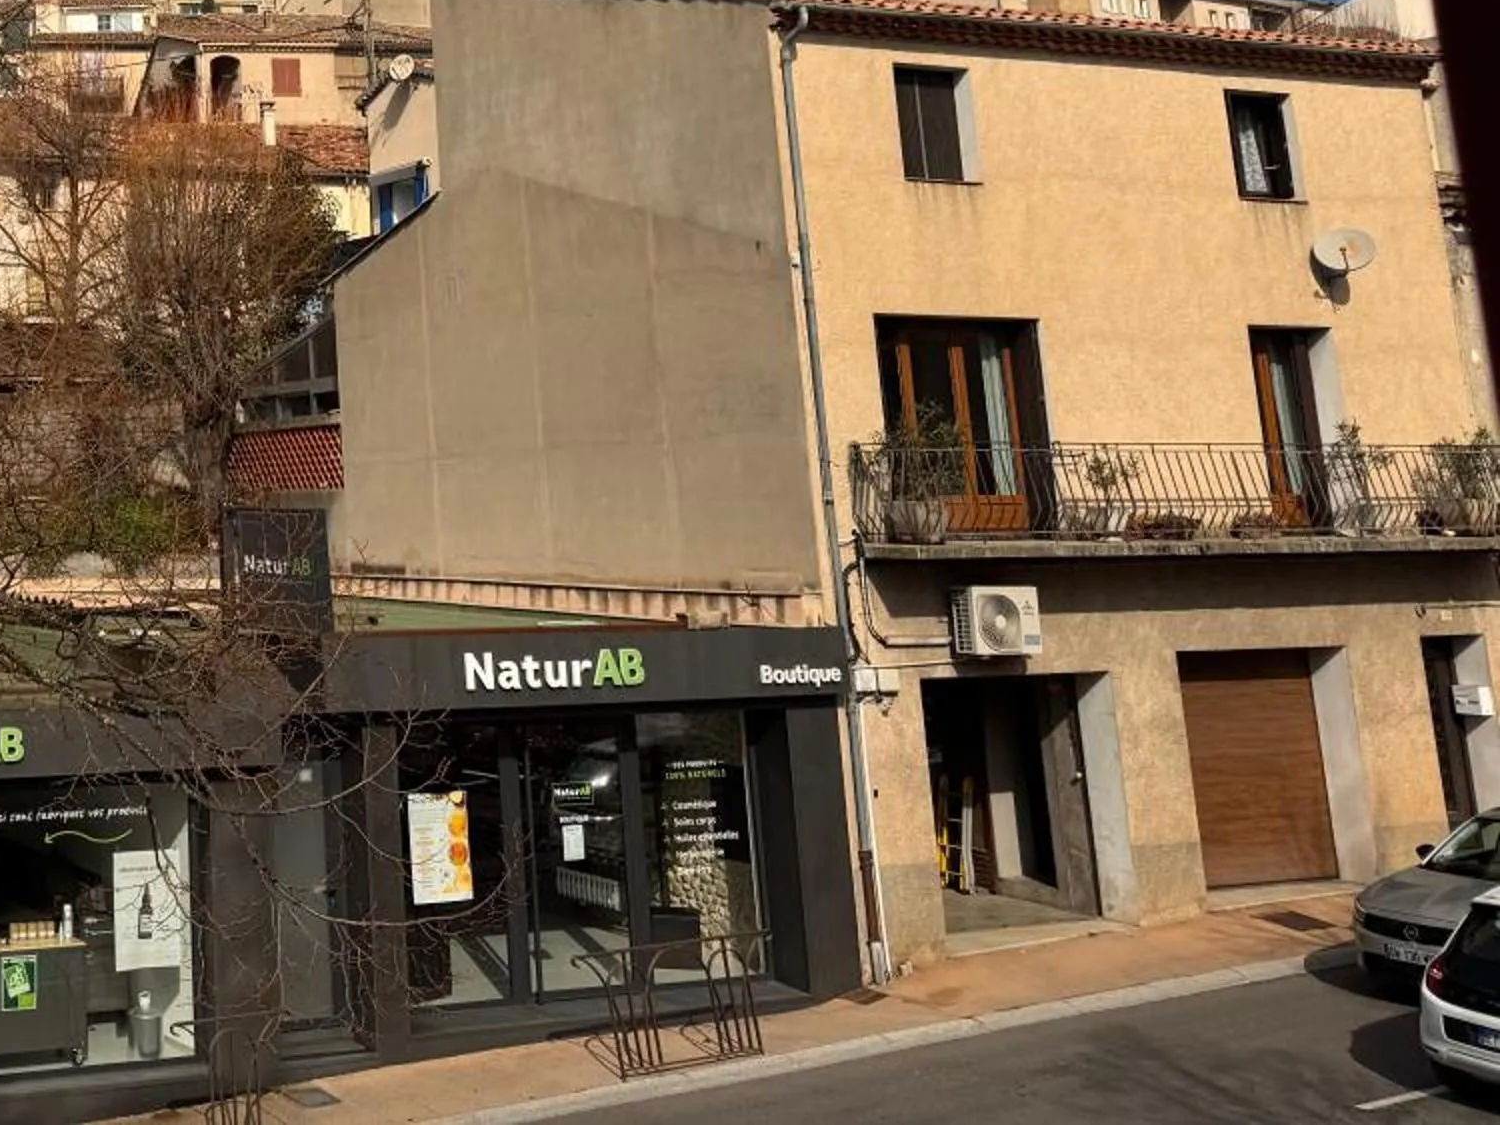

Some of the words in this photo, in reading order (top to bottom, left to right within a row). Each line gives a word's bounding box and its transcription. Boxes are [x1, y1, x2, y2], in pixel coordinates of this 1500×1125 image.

[243, 555, 311, 575] NaturAB
[463, 648, 645, 691] NaturAB
[760, 664, 842, 688] Boutique
[553, 785, 591, 796] NaturAB
